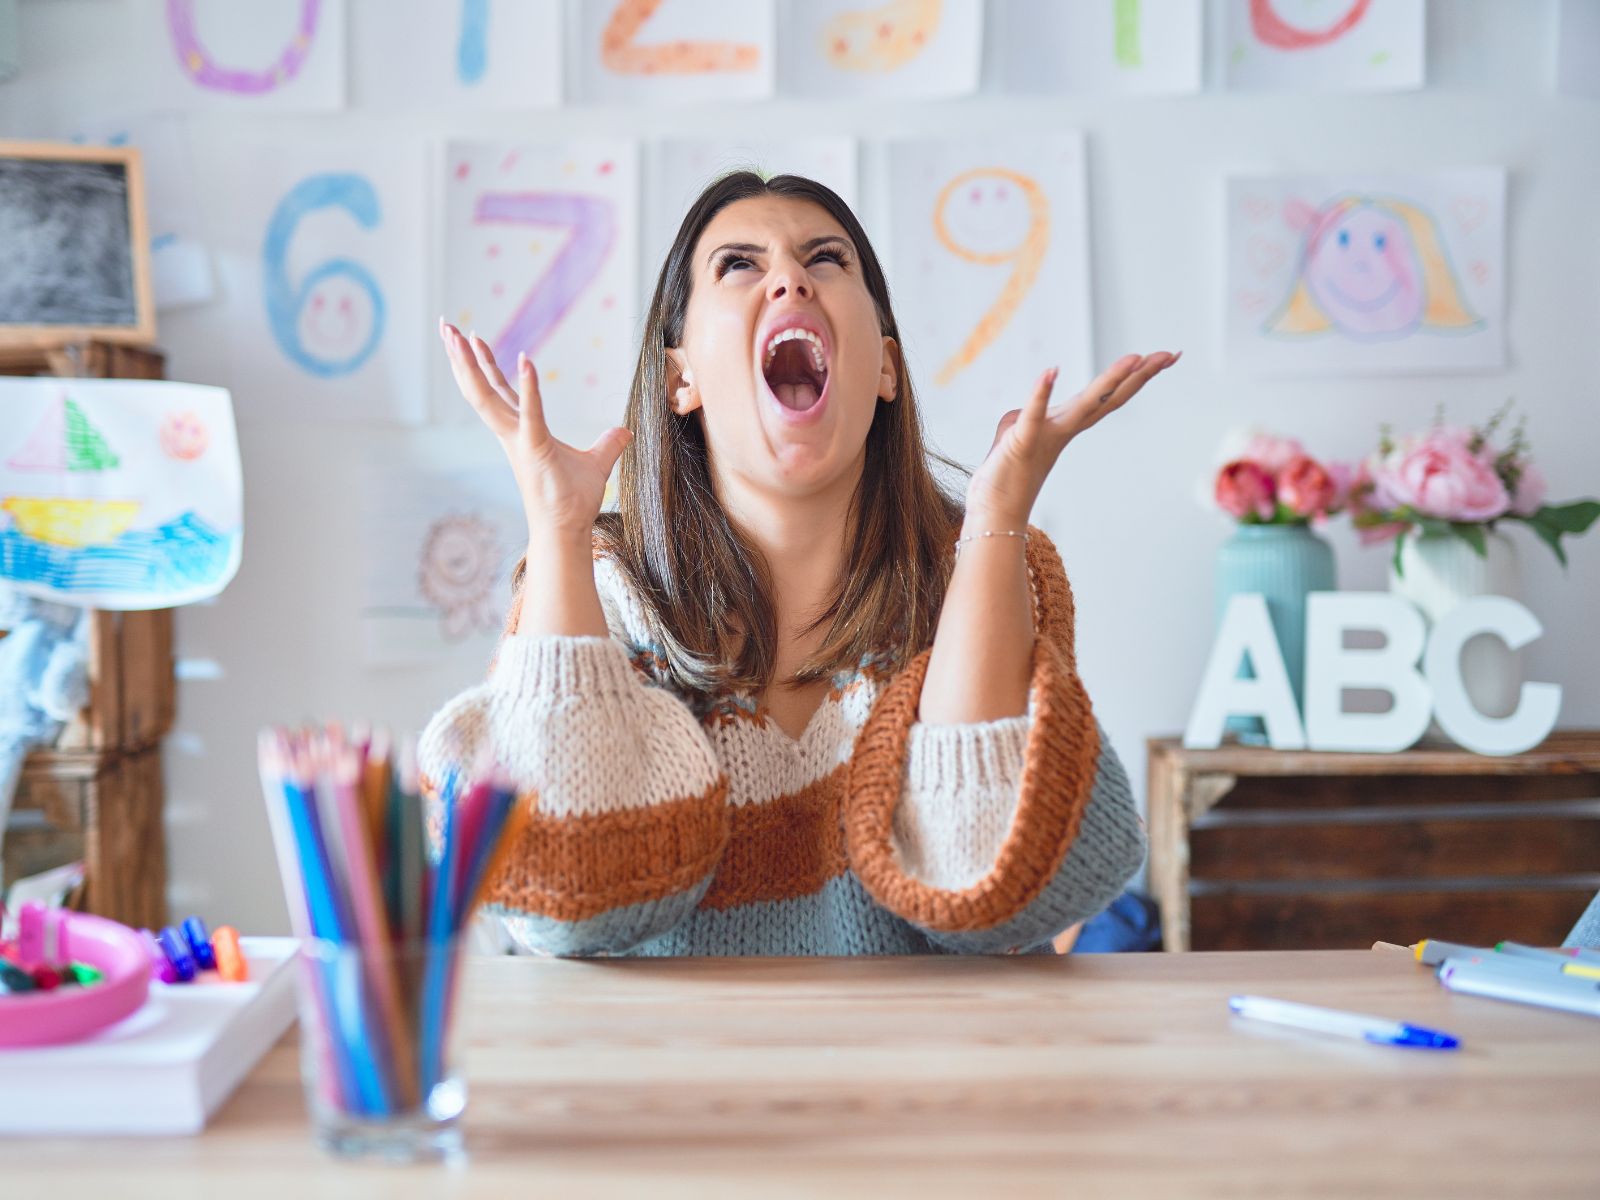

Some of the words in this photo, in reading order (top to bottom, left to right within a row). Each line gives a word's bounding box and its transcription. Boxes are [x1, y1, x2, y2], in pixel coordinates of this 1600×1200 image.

[264, 173, 385, 378] 6
[474, 192, 617, 386] 7
[933, 167, 1050, 386] 9
[1184, 591, 1562, 756] ABC
